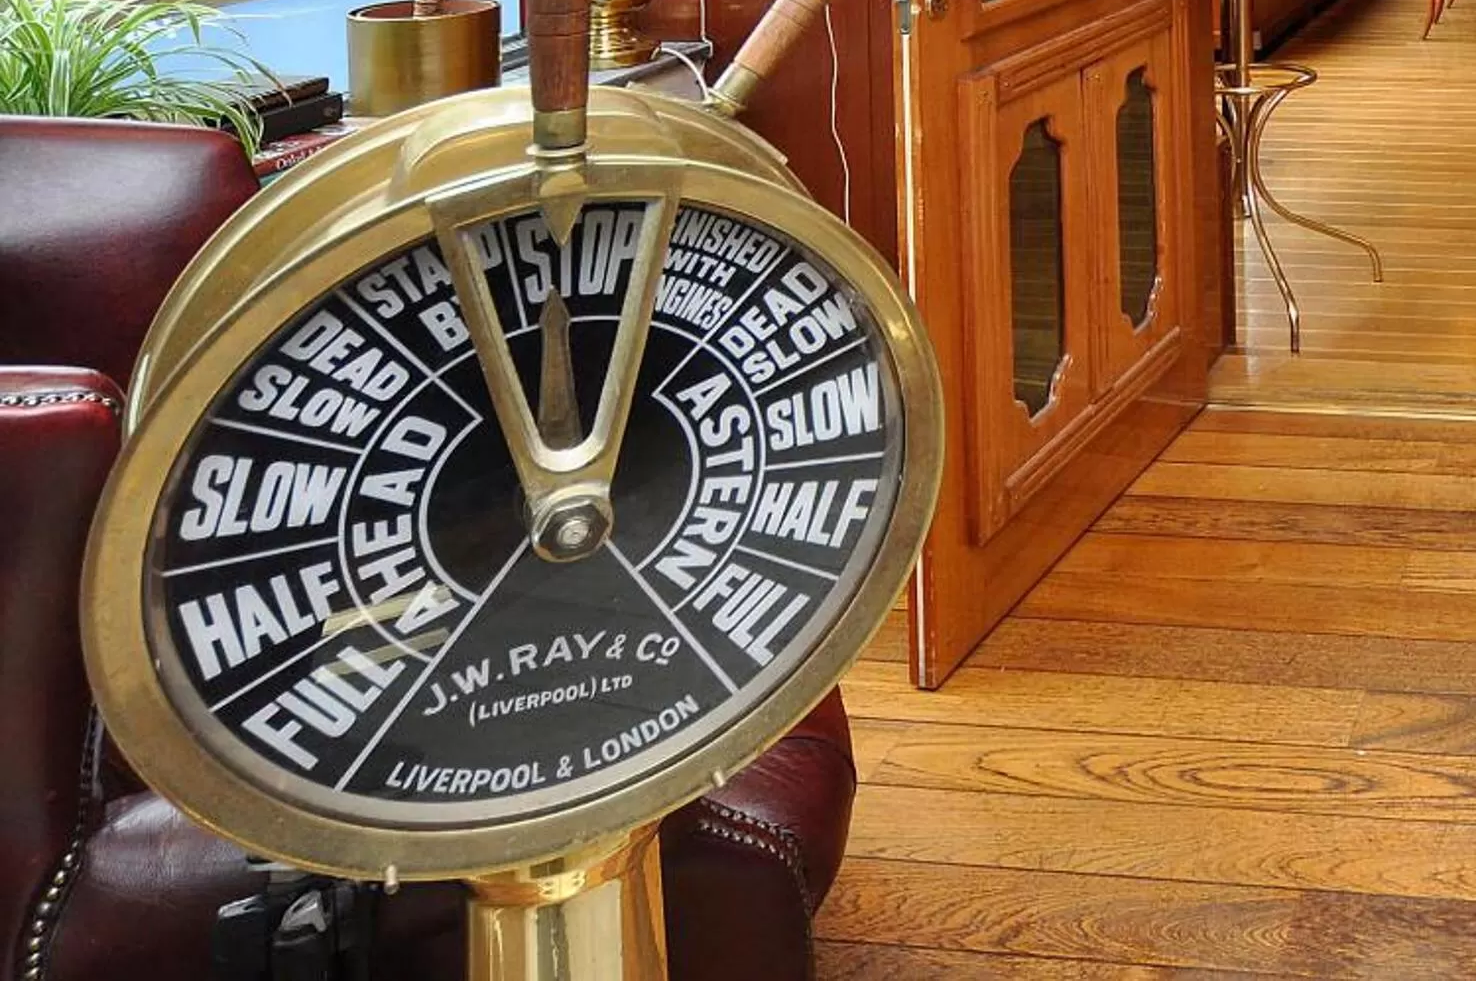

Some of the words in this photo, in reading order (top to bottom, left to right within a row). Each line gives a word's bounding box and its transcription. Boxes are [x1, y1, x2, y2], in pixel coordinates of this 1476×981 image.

[672, 209, 780, 273] INISHED
[655, 275, 733, 331] NGINES
[718, 262, 829, 359] DEAD
[742, 291, 857, 384] SLOW
[238, 364, 381, 437] SLOW
[279, 310, 410, 401] DEAD
[766, 362, 880, 451] SLOW
[179, 455, 348, 542] SLOW
[353, 415, 460, 635] AHEAD
[654, 372, 754, 591] ASTERN
[750, 479, 879, 548] HALF
[179, 562, 341, 681] HALF
[509, 630, 606, 676] RAY
[606, 634, 627, 660] &
[692, 563, 810, 667] FULL
[242, 646, 406, 771] FULL
[385, 761, 546, 795] LIVERPOOL
[556, 755, 573, 779] &
[583, 694, 700, 770] LONDON
[469, 677, 597, 727] (LIVERPOOL)
[601, 674, 633, 693] LTD
